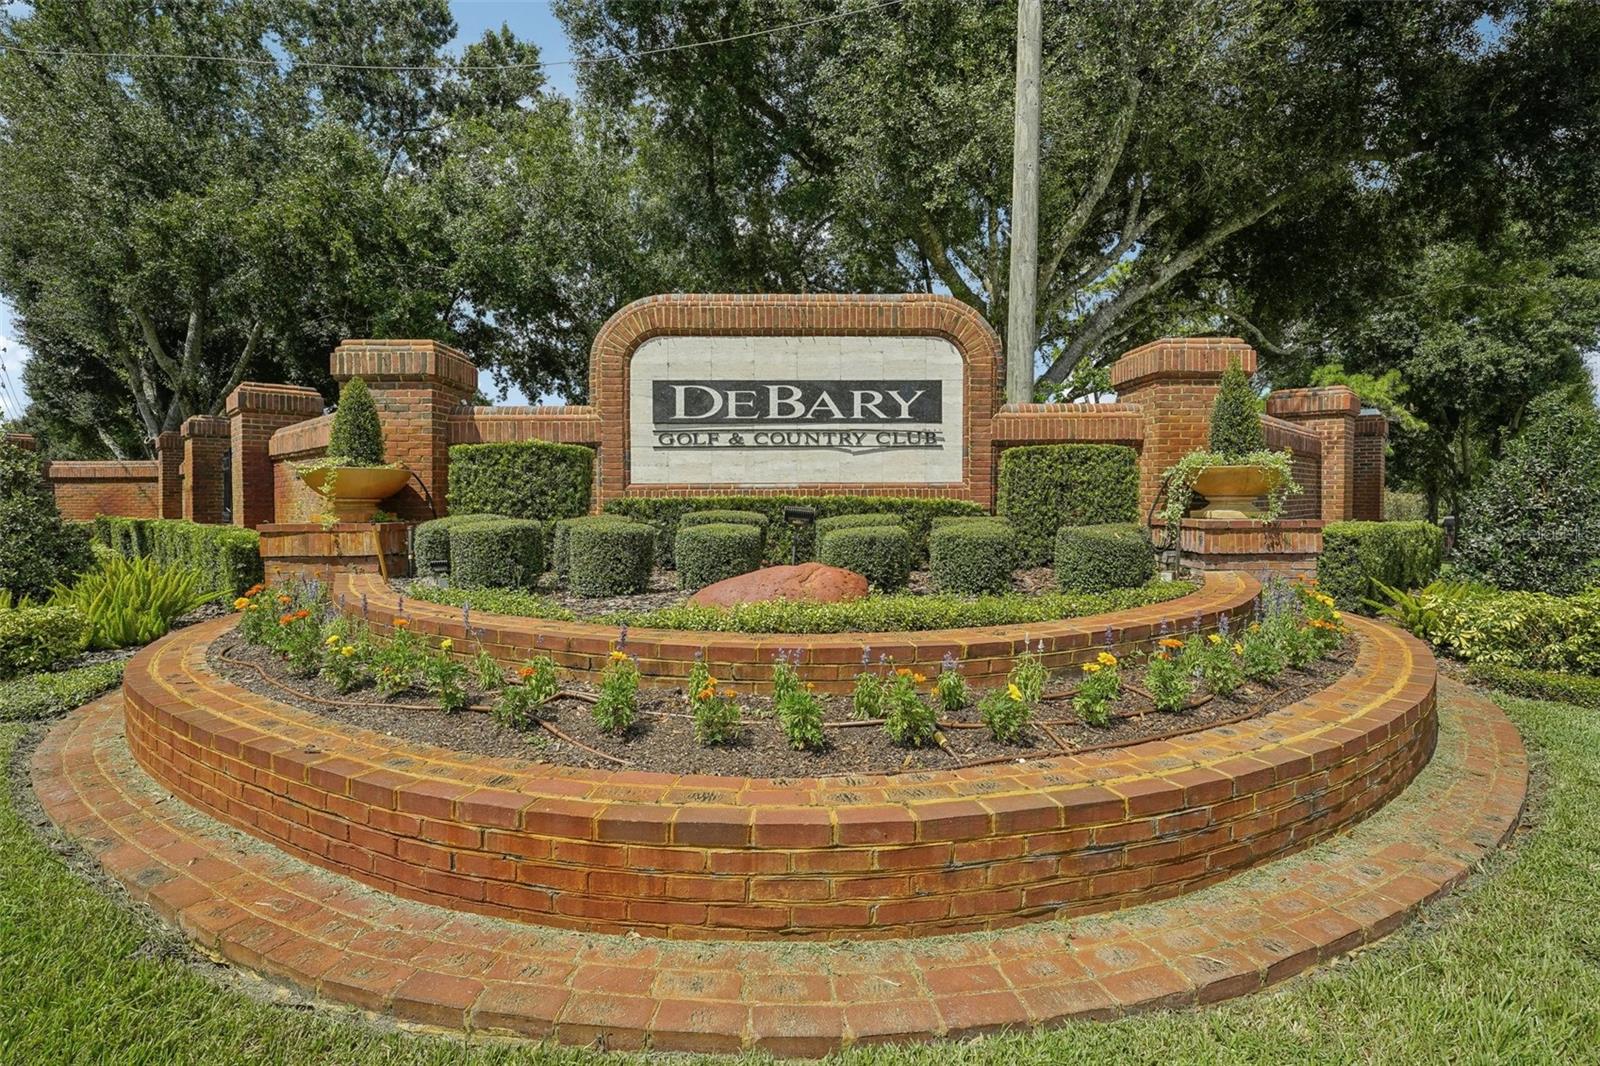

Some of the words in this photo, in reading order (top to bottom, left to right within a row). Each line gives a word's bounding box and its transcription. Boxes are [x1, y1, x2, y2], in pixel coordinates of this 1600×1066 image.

[670, 384, 926, 419] DEBARY
[658, 432, 720, 446] GOLF
[728, 432, 745, 446] &
[754, 432, 866, 446] COUNTRY
[876, 432, 938, 446] CLUB
